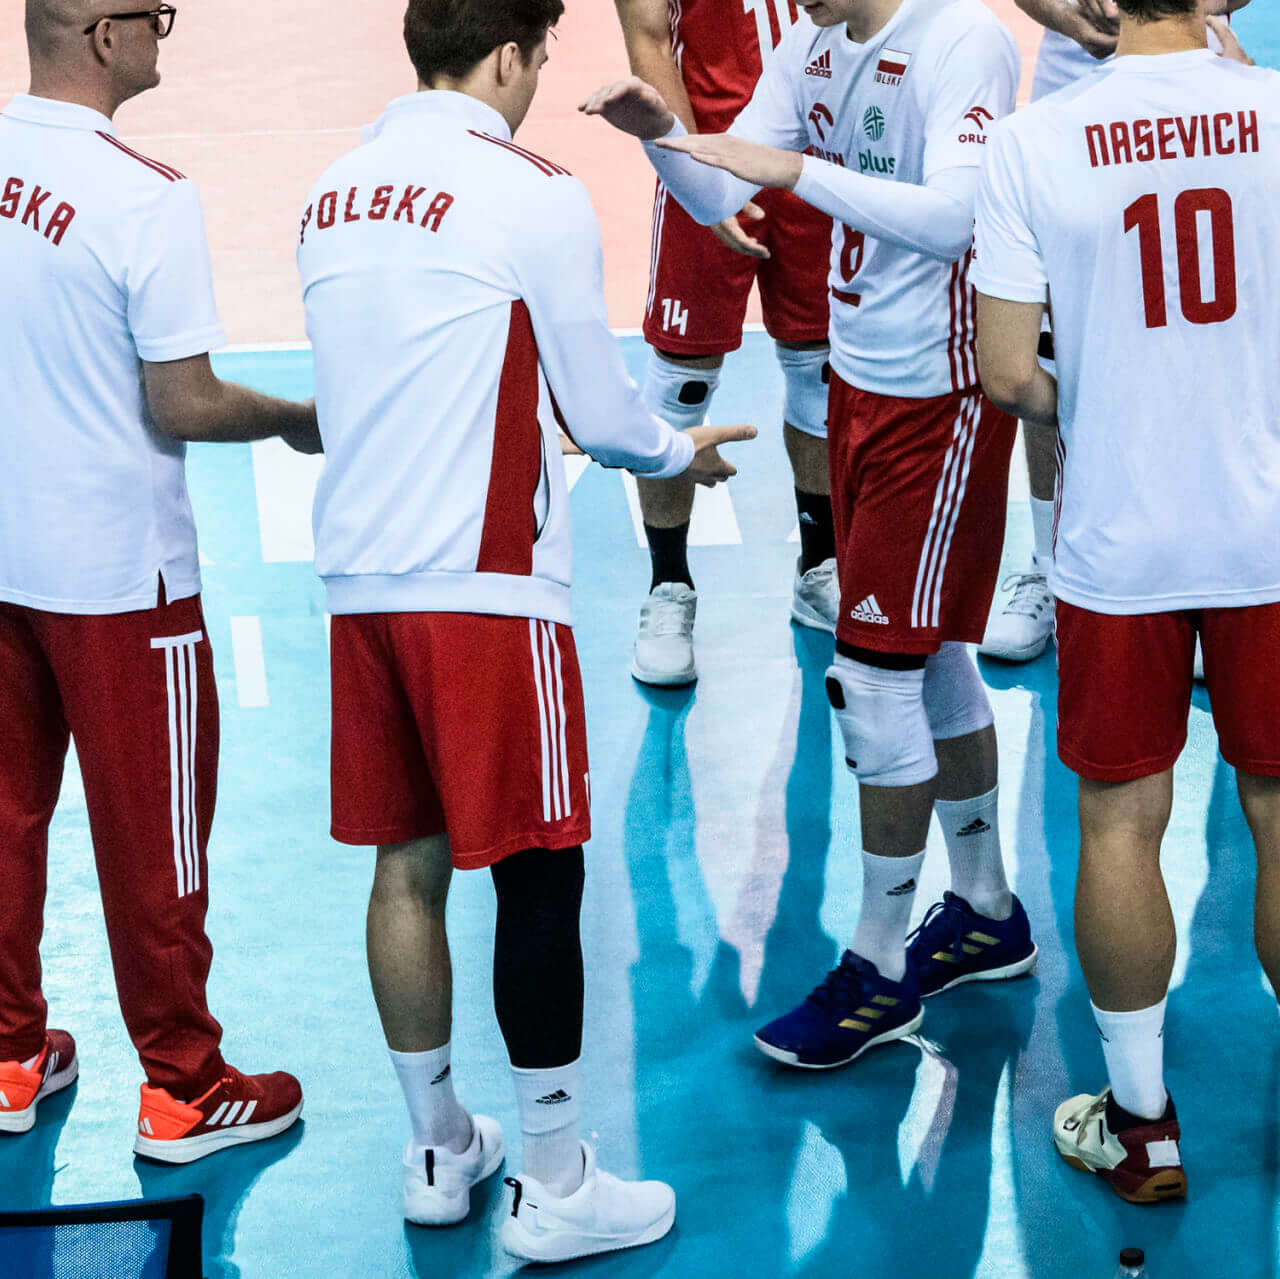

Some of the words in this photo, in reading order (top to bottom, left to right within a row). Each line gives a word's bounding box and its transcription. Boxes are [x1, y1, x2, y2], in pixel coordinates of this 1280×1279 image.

[1085, 109, 1260, 169] NASEVICH
[1123, 187, 1238, 330] 10
[661, 297, 689, 337] 14
[850, 610, 890, 626] adidas
